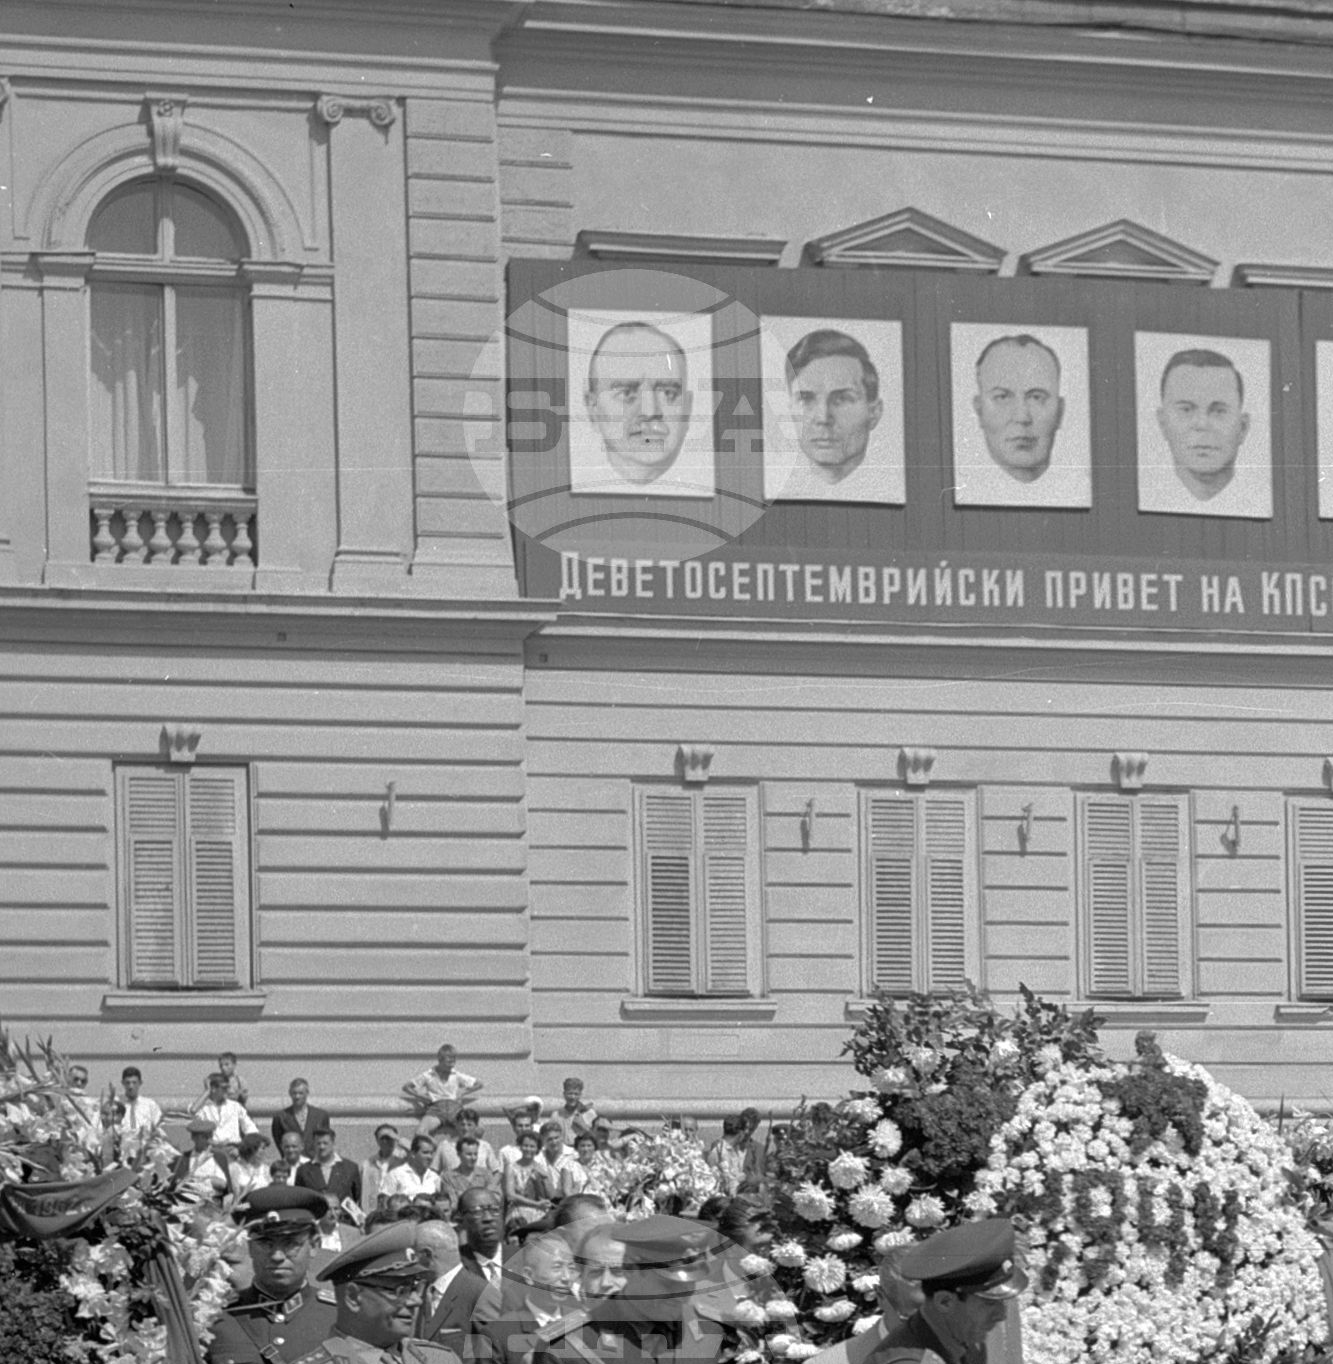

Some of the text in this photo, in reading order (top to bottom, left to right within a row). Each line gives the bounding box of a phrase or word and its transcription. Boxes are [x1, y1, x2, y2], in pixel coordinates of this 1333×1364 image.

[560, 551, 1025, 607] ДЕВЕТОСЕПТЕМВРИЙСКИ
[1045, 571, 1182, 612] ПРИВЕТ
[1201, 575, 1246, 614] НА
